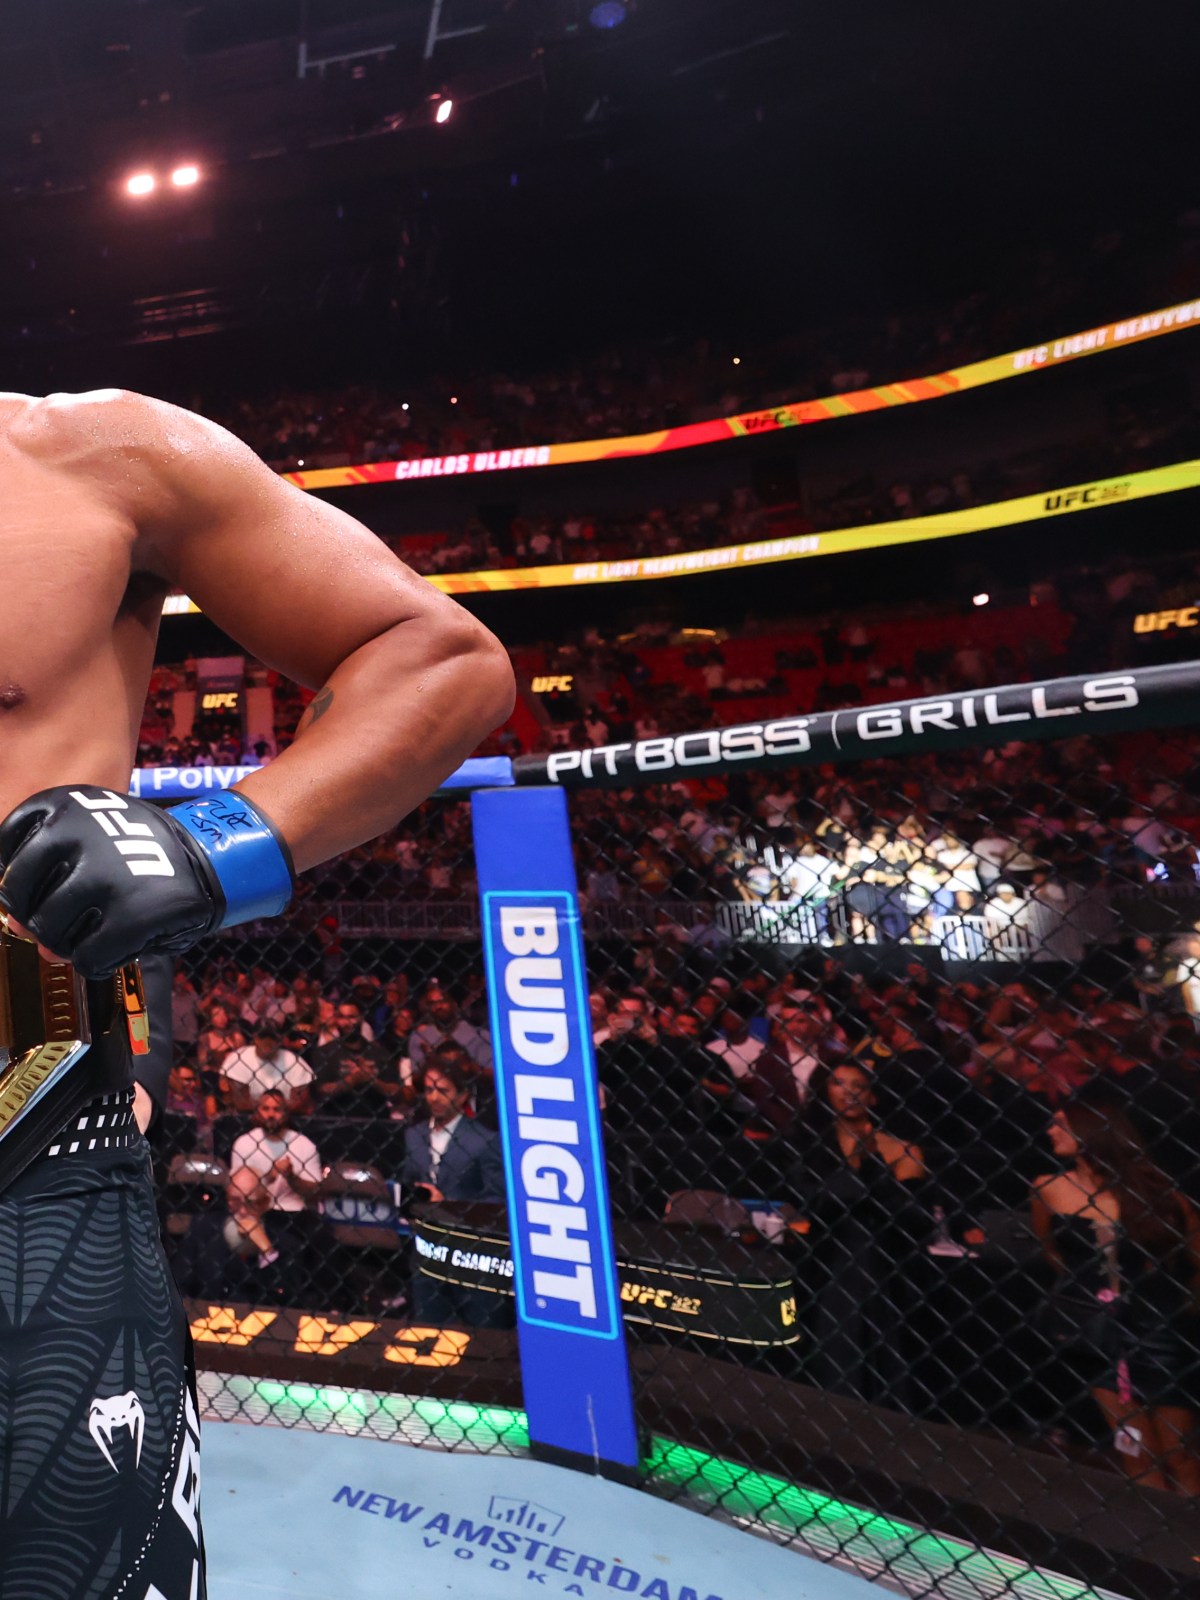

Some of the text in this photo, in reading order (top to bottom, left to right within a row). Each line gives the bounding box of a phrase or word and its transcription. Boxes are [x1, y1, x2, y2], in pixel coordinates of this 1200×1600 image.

[1013, 346, 1048, 369] UFC
[1053, 328, 1108, 358] LIGHT
[395, 446, 550, 480] CARLOS ULBERG
[1045, 487, 1097, 511] UFC
[573, 536, 820, 580] UFC LIGHT HEAVYWEIGHT CHAMPION
[1133, 606, 1199, 634] UFC
[202, 693, 239, 708] UFC
[531, 675, 573, 692] UFC
[856, 675, 1138, 741] GRILLS
[68, 790, 175, 877] UFC
[500, 906, 598, 1320] BUD LIGHT
[620, 1282, 673, 1309] UFC
[332, 1485, 424, 1524] NEW
[423, 1536, 585, 1597] VODKA
